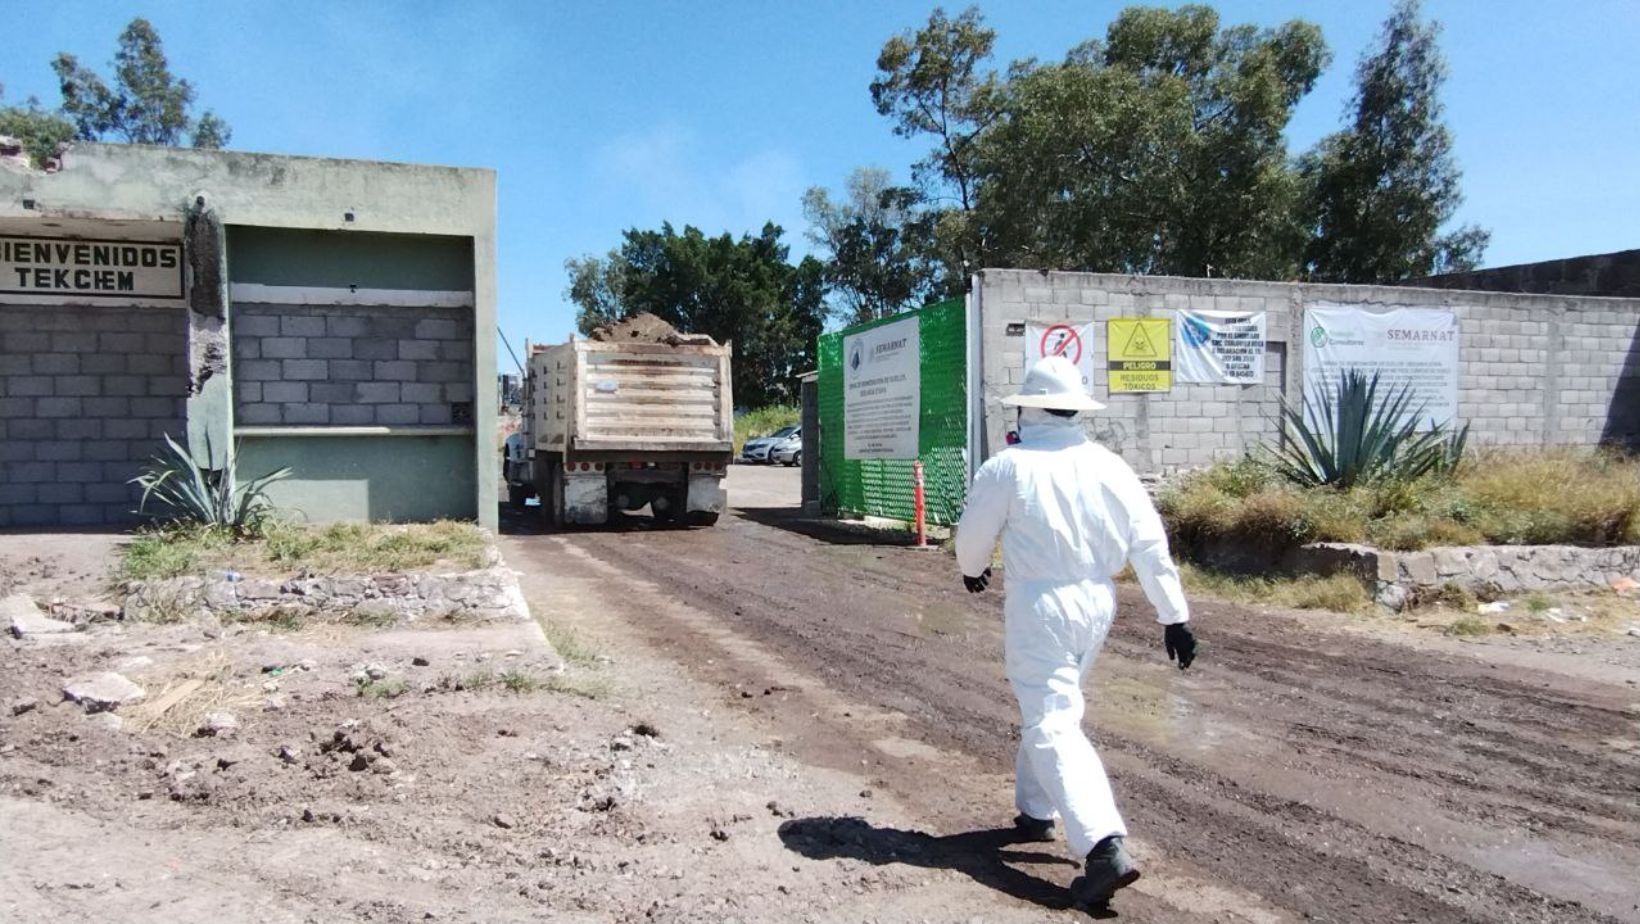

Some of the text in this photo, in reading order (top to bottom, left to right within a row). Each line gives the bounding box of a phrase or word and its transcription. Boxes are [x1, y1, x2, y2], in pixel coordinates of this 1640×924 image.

[0, 242, 177, 268] IENVENIDOS
[15, 267, 134, 291] TEKCHEM
[1387, 329, 1455, 341] SEMARNAT
[1122, 362, 1157, 370] PELIGRO
[1120, 374, 1159, 382] RESIDUOS
[1123, 383, 1157, 391] TOXICOS
